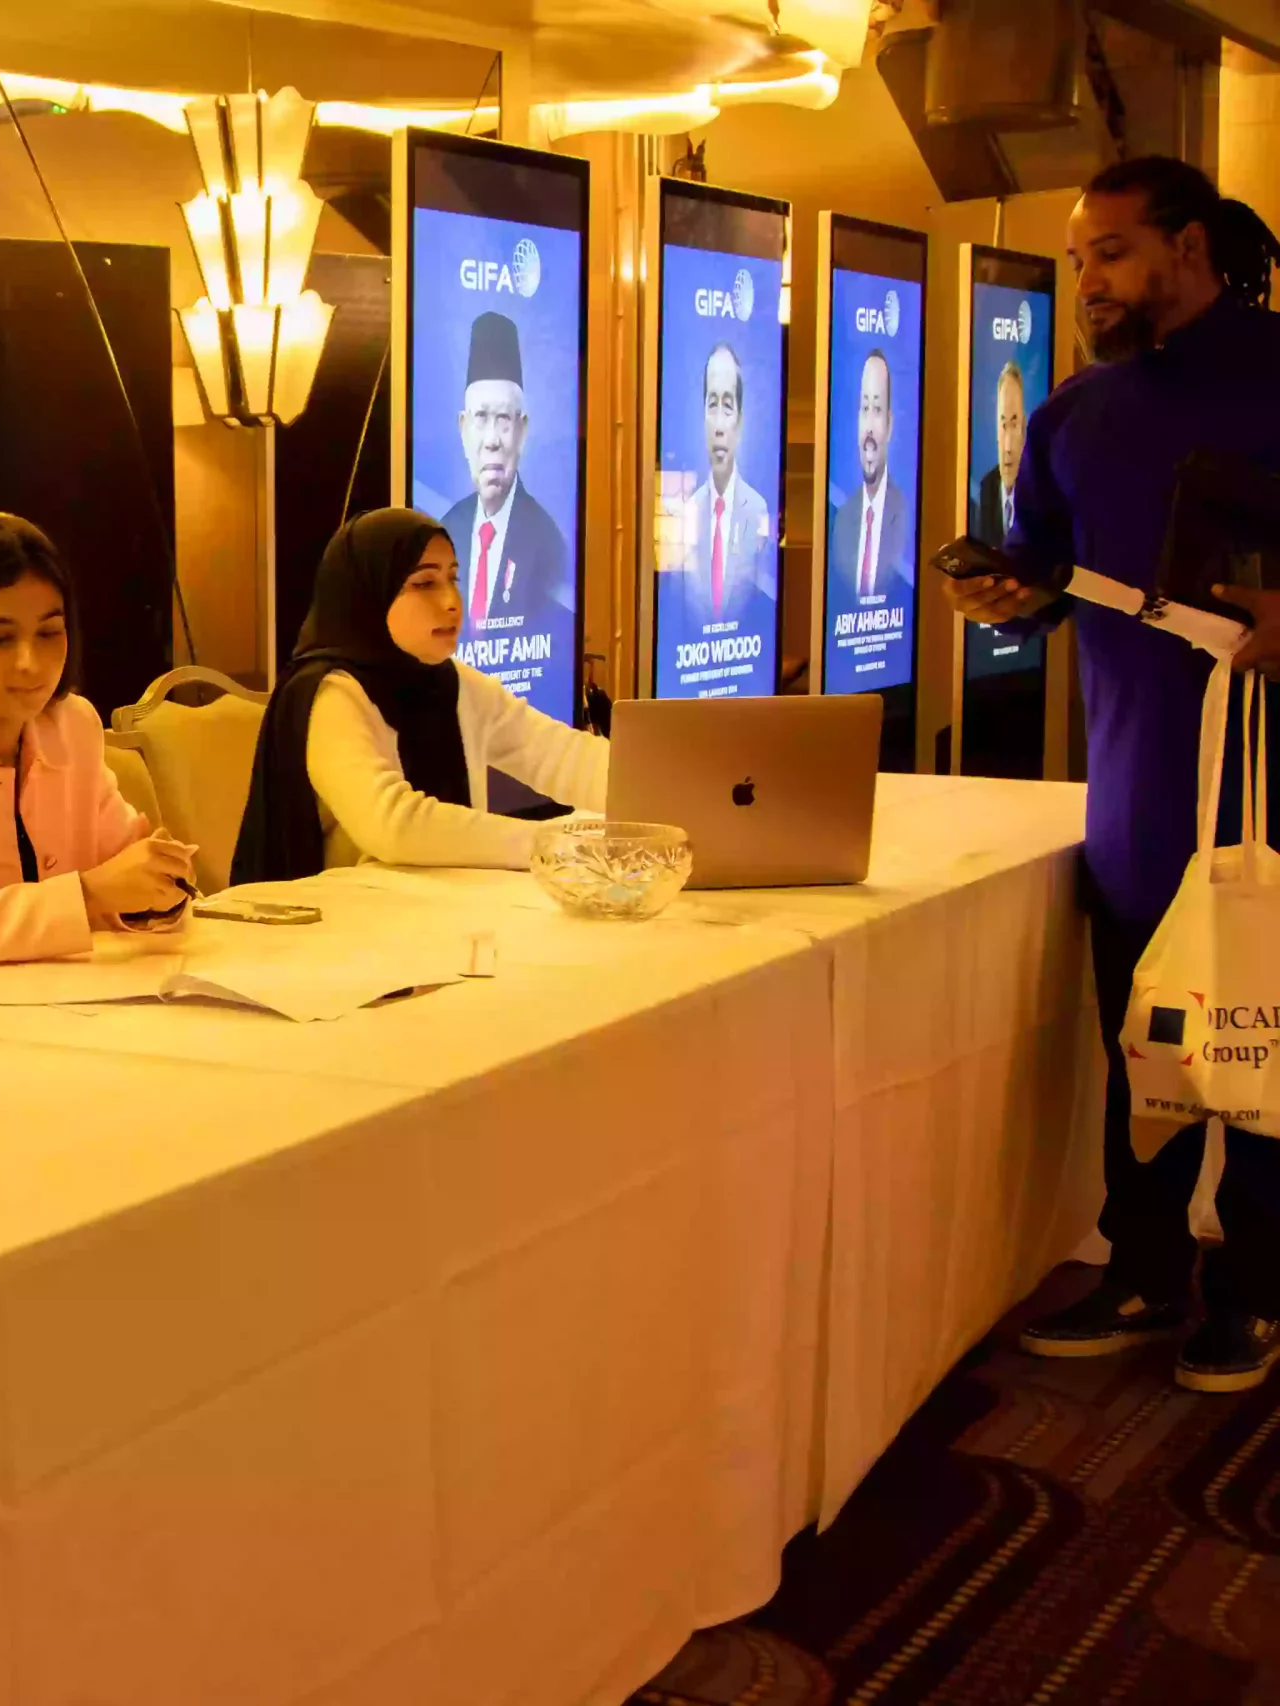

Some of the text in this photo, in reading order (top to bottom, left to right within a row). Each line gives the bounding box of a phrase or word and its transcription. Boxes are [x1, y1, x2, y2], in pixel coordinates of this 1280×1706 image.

[460, 259, 514, 294] GIFA
[695, 288, 735, 319] GIFA
[856, 307, 886, 335] GIFA
[993, 317, 1019, 343] GIFA
[834, 607, 904, 636] ABIY AHMED ALI
[510, 634, 551, 662] AMIN
[676, 635, 762, 669] JOKO WIDODO
